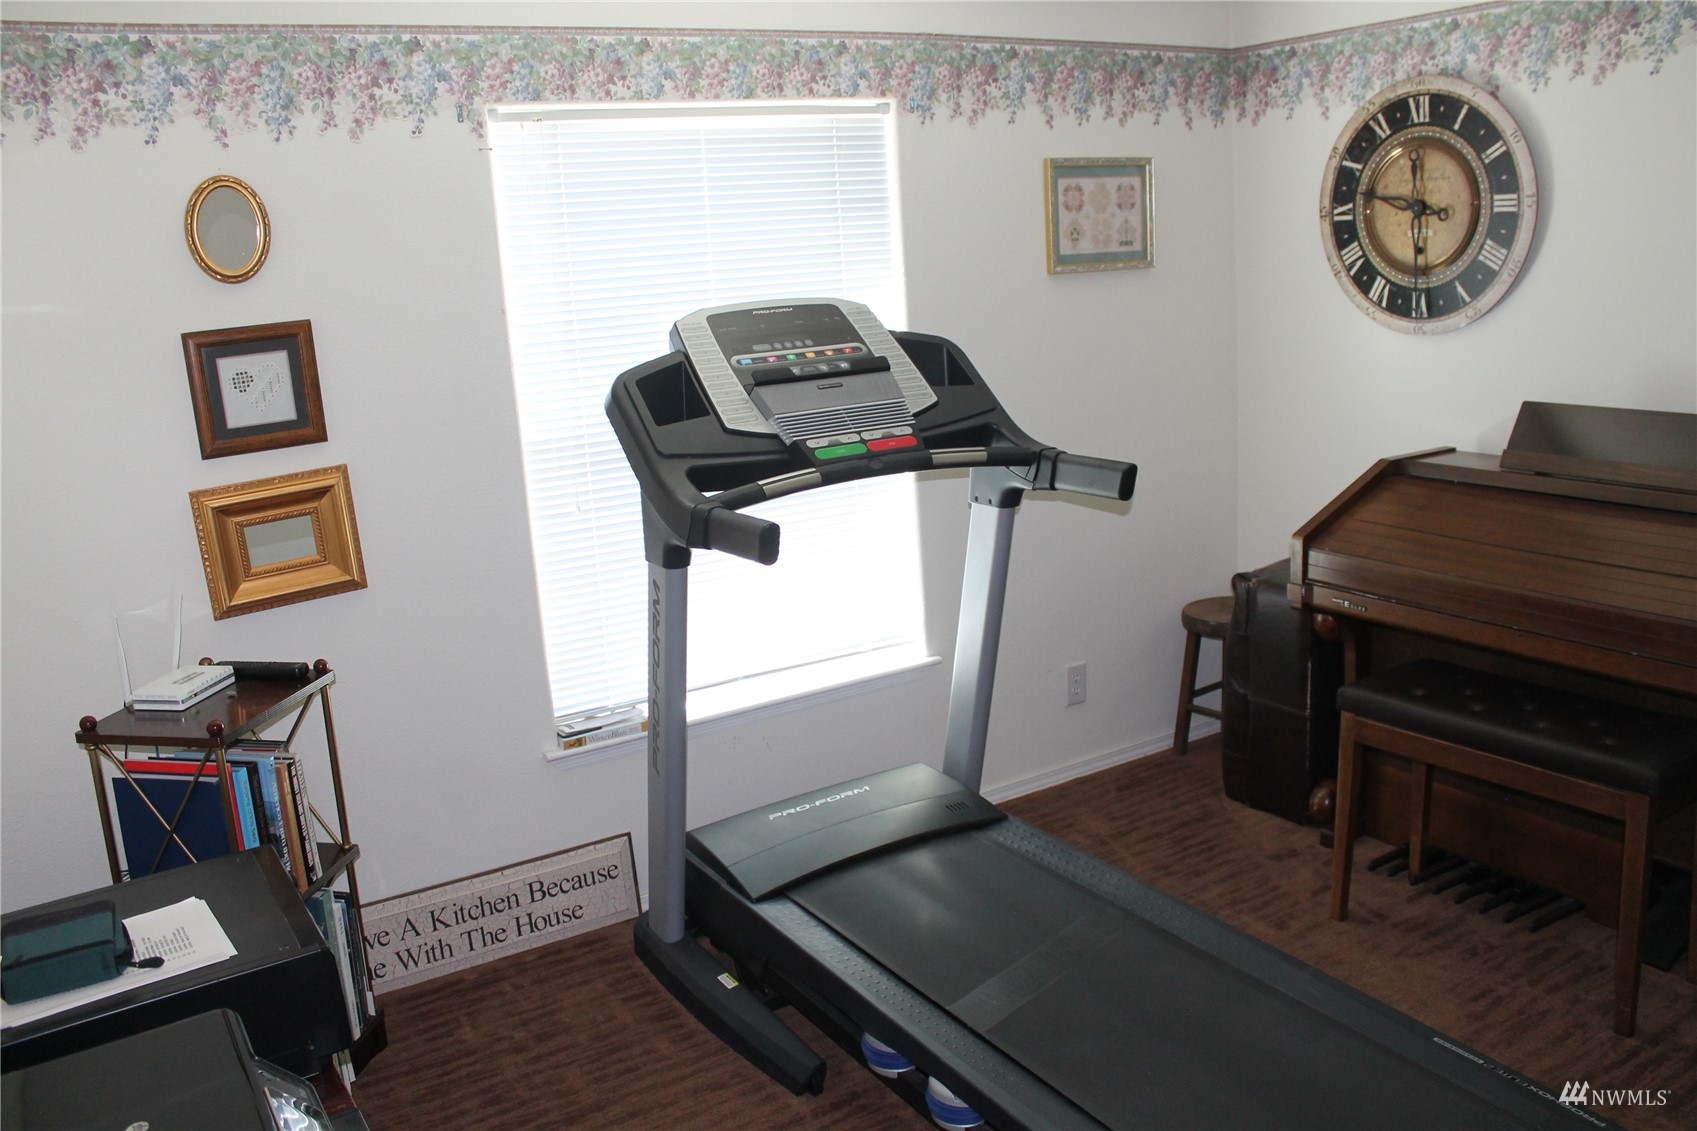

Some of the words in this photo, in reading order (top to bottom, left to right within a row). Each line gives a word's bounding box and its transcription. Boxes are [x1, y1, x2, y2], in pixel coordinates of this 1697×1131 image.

[1408, 95, 1431, 123] XII
[1454, 104, 1469, 130] I
[1369, 112, 1392, 142] XI
[1481, 140, 1507, 164] II
[1494, 194, 1519, 212] III
[1340, 241, 1365, 276] VIII
[1479, 239, 1507, 271] IIII
[1368, 275, 1390, 308] VII
[752, 307, 793, 315] PRO-FORM
[651, 577, 662, 777] PRO-FORM
[768, 786, 870, 820] PRO-FORM
[400, 917, 421, 941] A
[430, 892, 521, 932] Kitchen
[528, 863, 620, 904] Because
[395, 937, 454, 971] With
[460, 927, 509, 952] The
[515, 903, 585, 937] House
